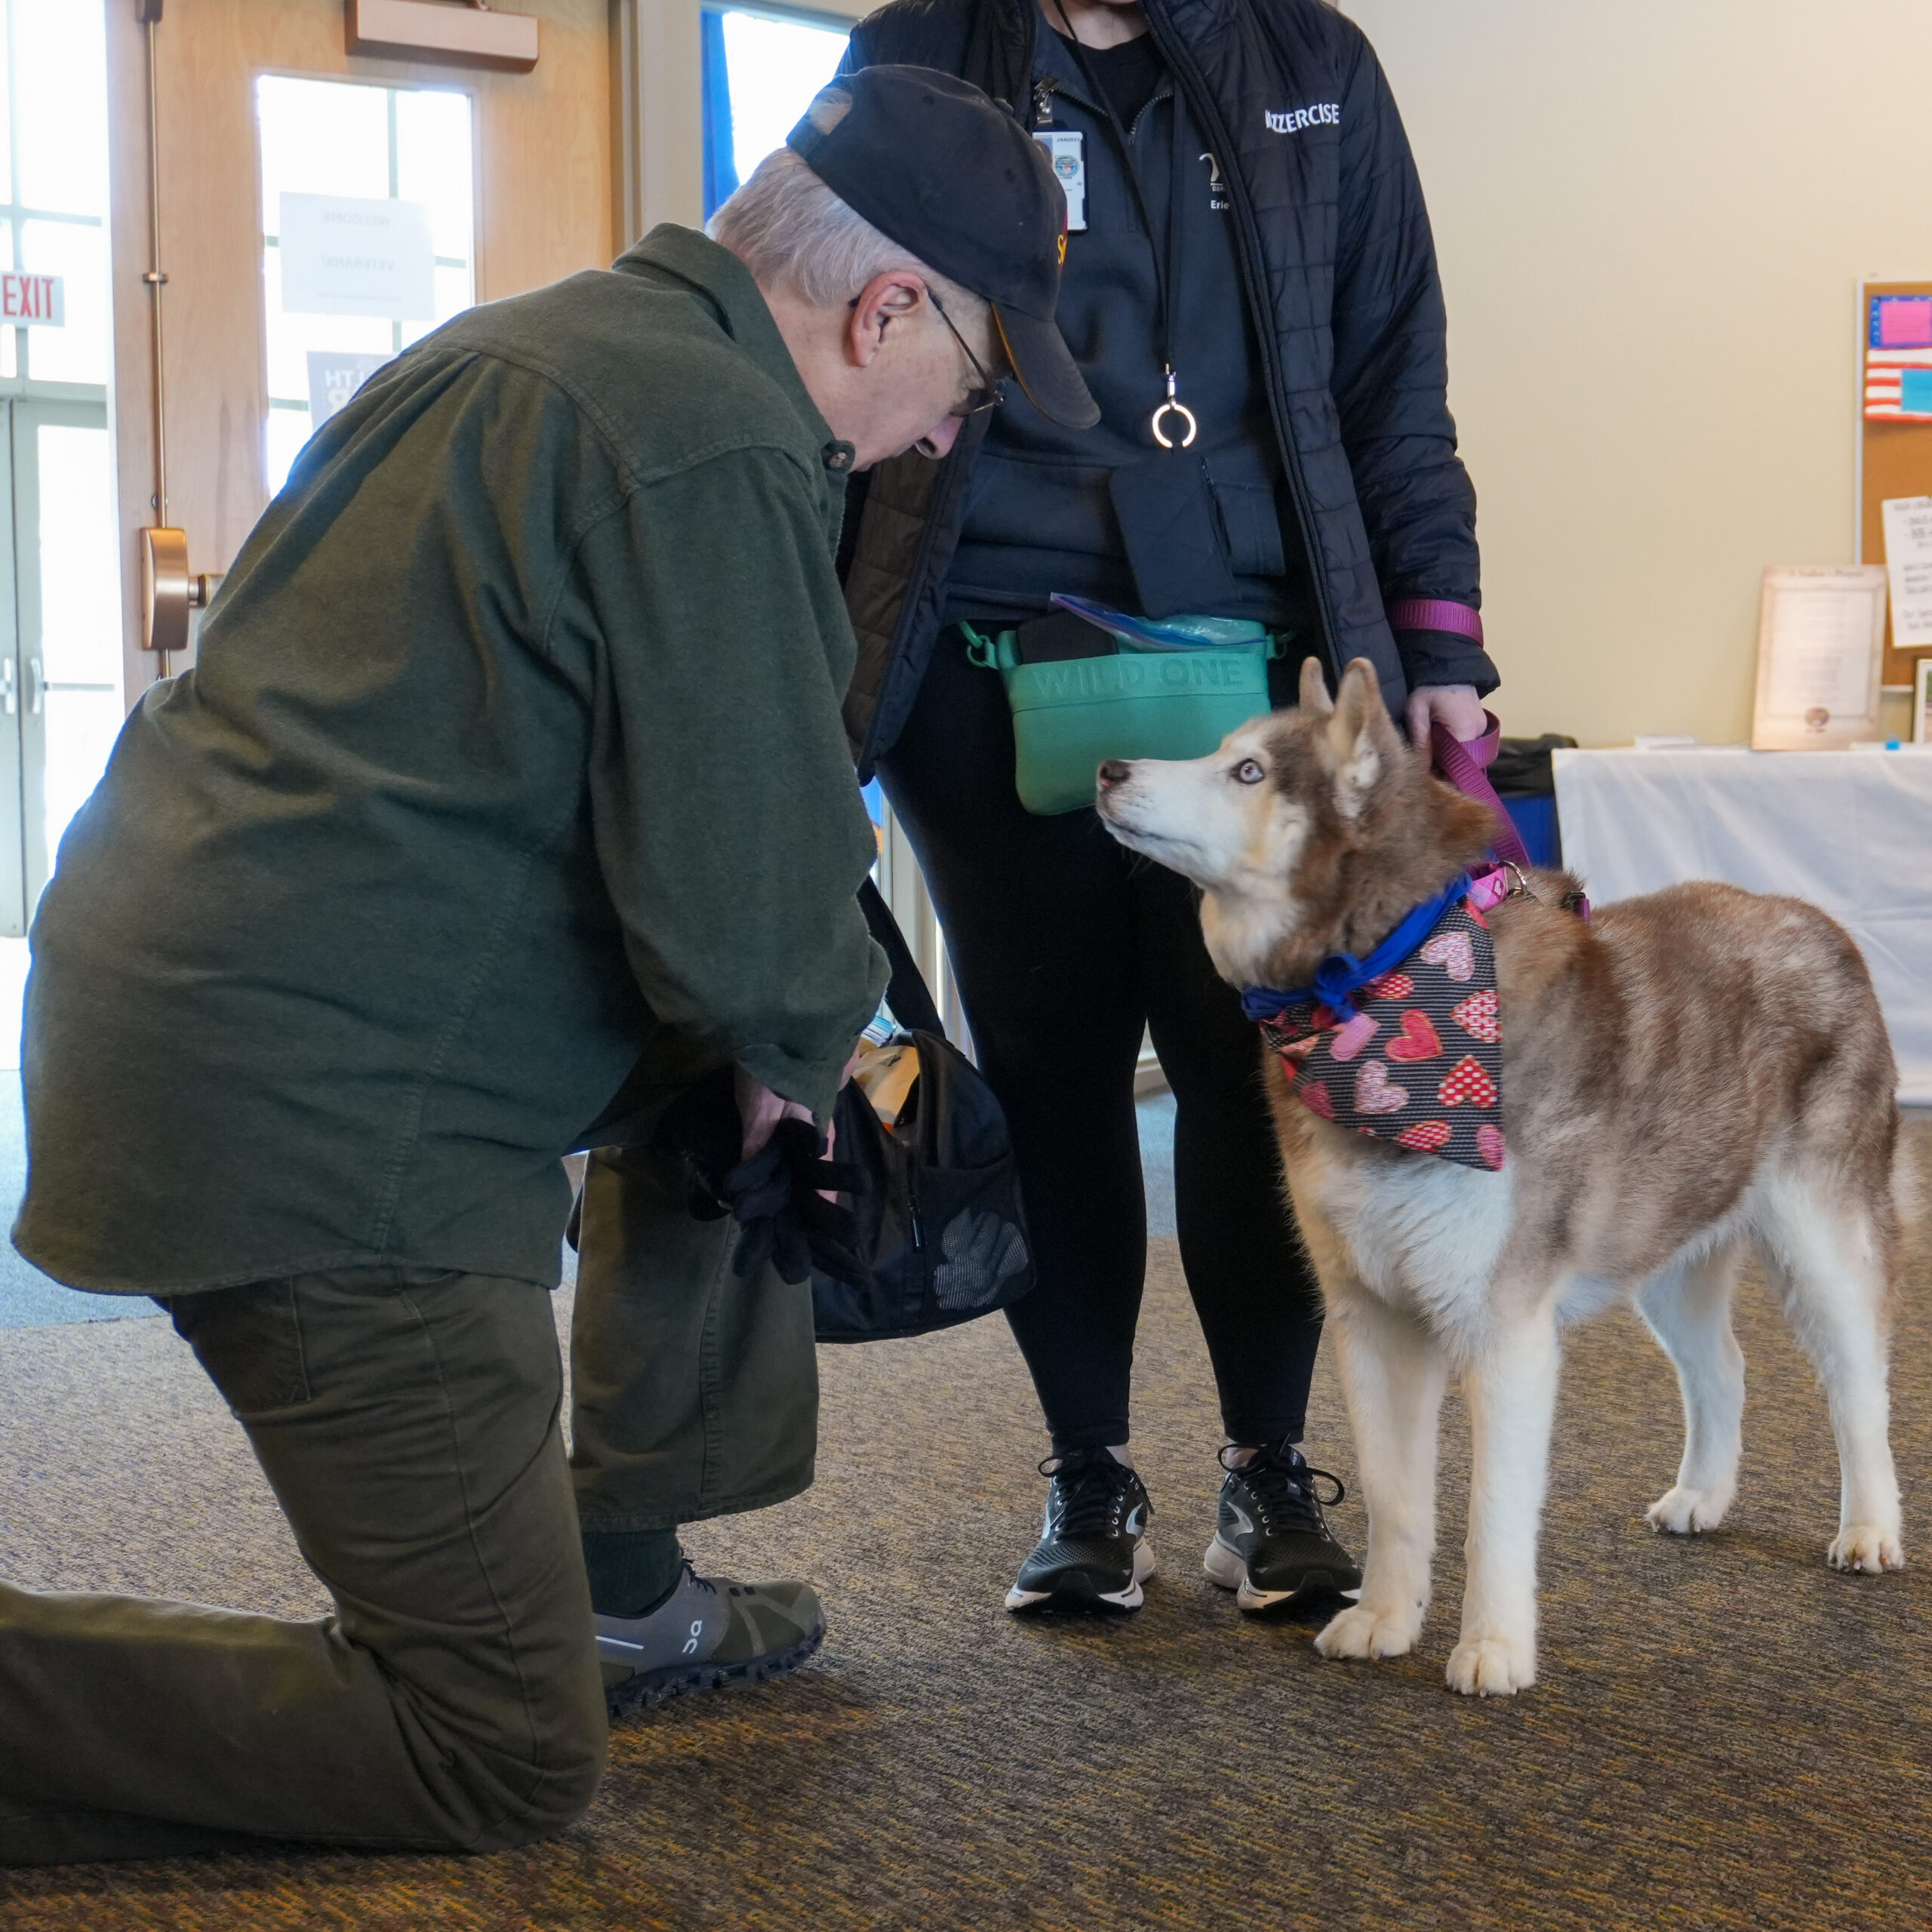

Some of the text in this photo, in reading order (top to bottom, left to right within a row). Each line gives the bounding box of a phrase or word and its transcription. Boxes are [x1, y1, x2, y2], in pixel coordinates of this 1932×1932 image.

[2, 275, 54, 320] EXIT
[1031, 658, 1245, 697] WILD ONE
